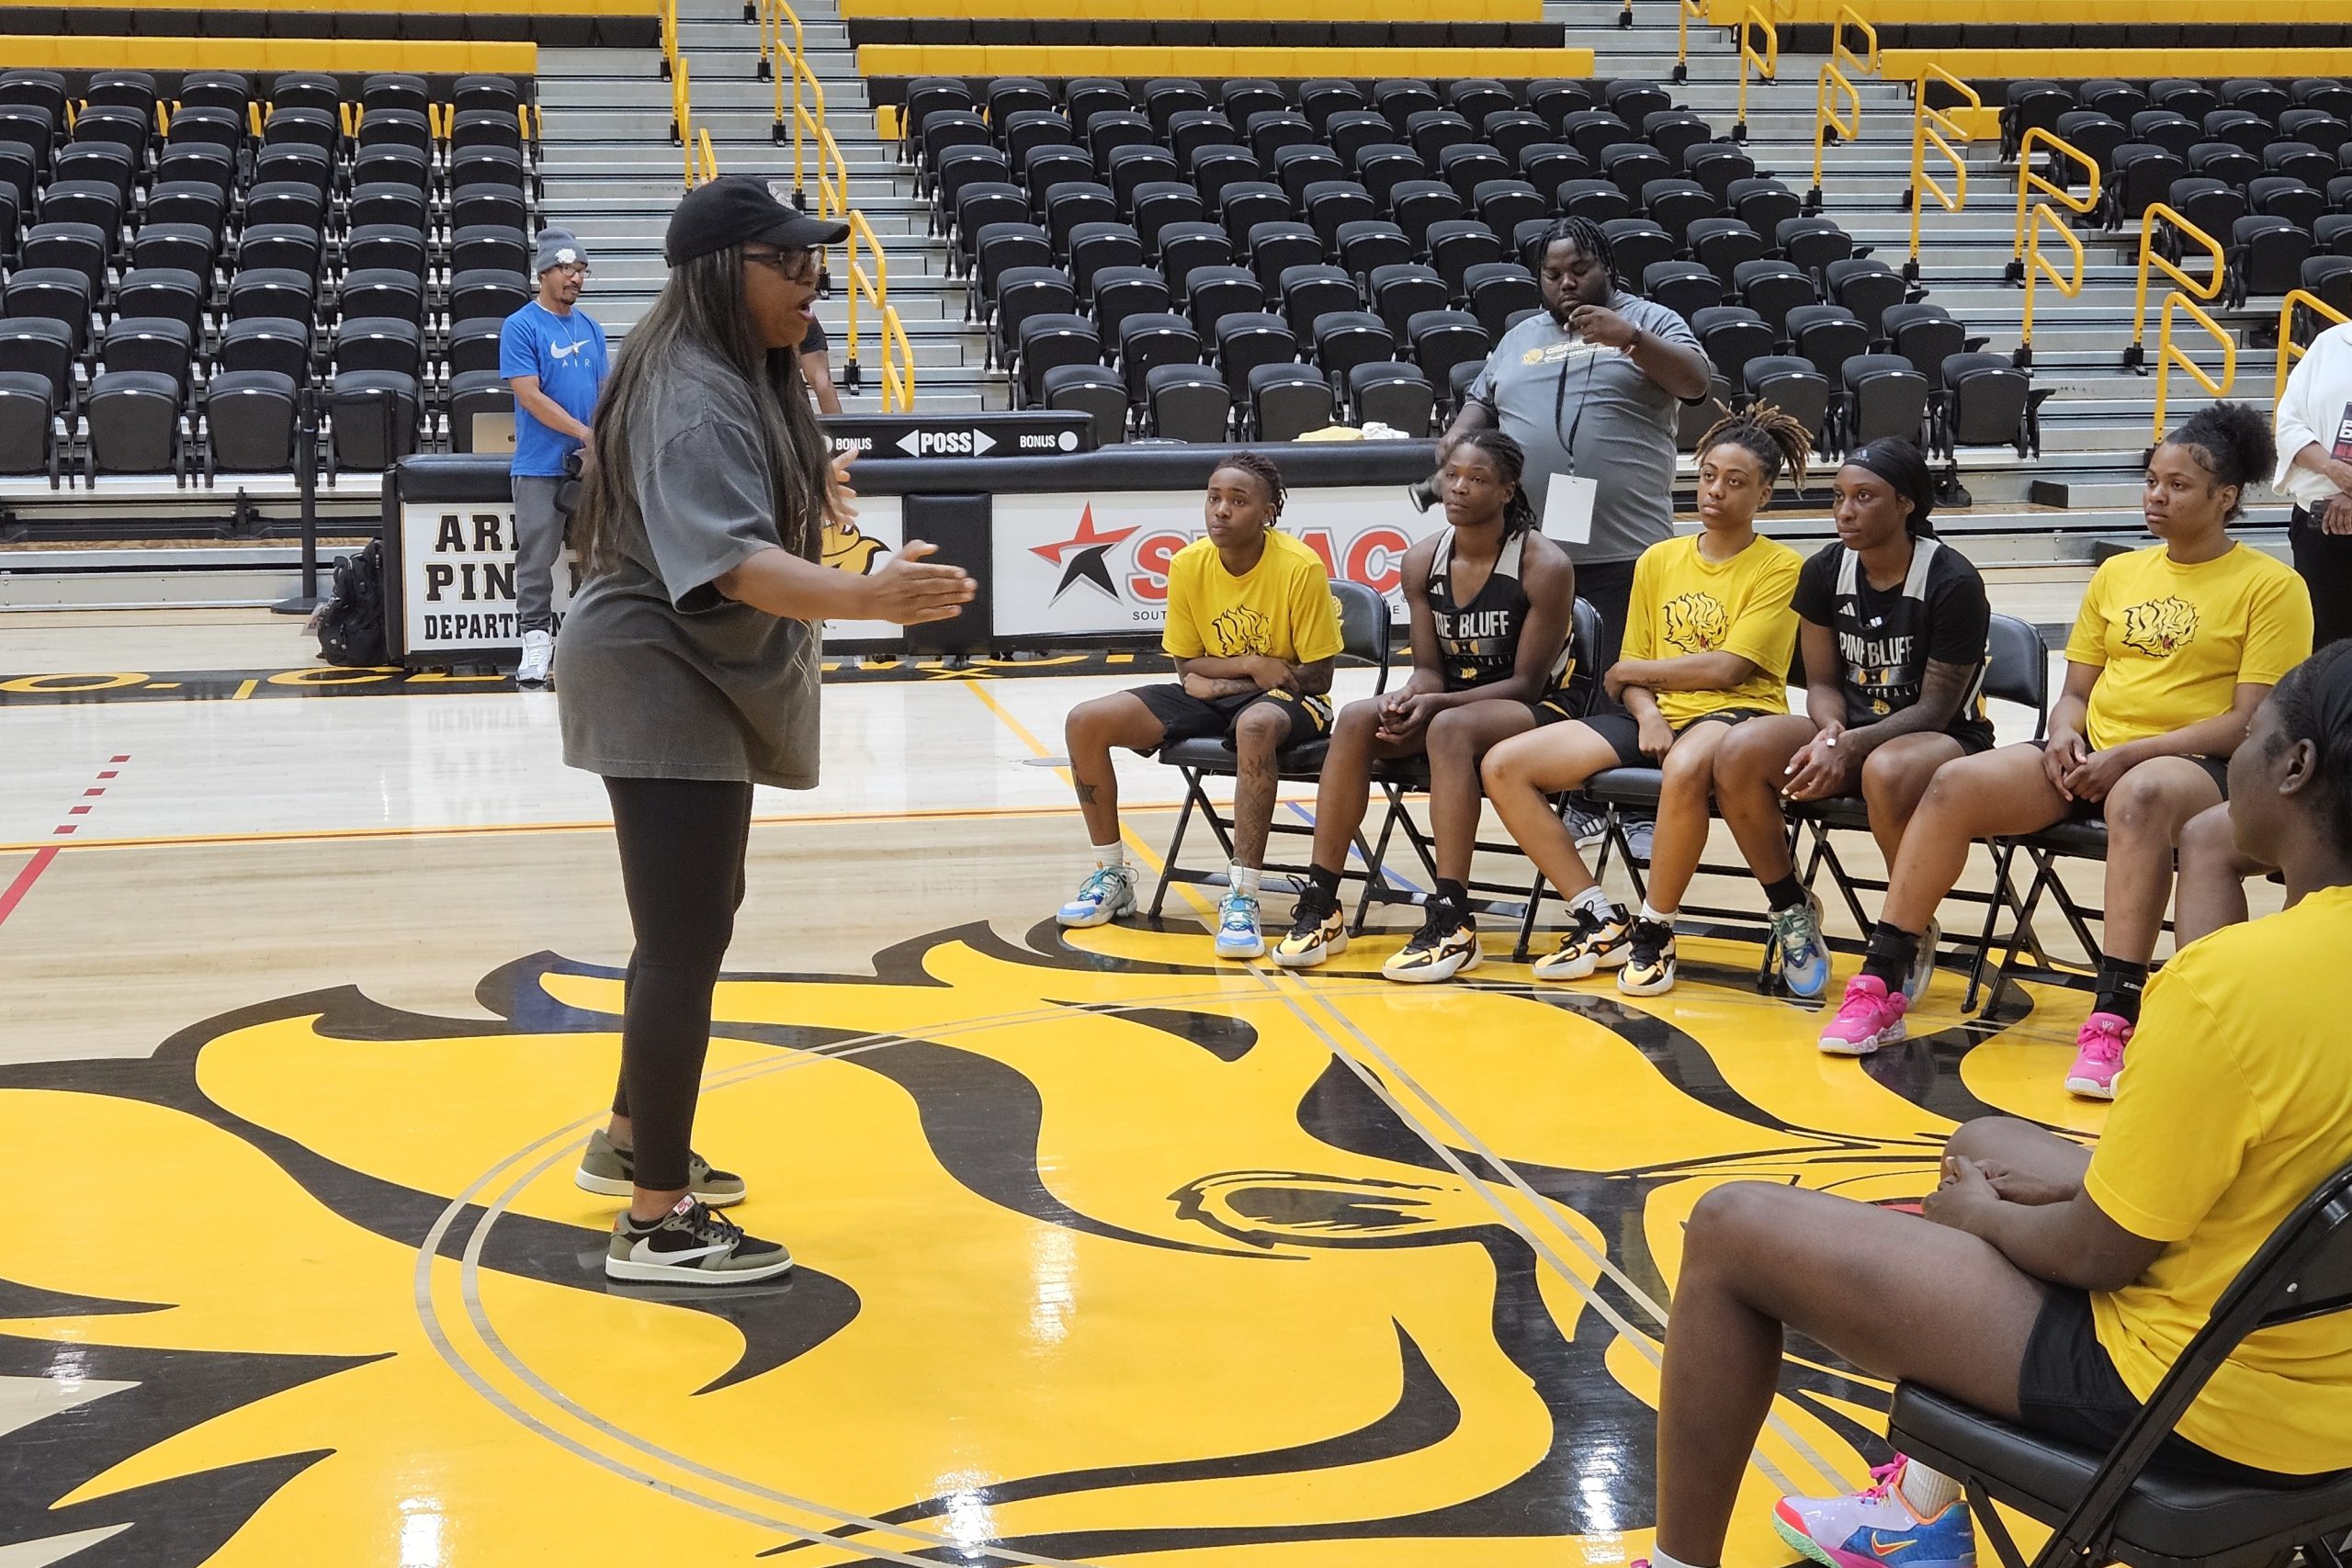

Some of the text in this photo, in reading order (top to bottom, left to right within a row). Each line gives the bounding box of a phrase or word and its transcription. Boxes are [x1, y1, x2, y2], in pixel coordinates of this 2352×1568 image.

[562, 358, 591, 368] AIR
[835, 432, 1056, 454] BONUS POSS BONUS
[425, 563, 515, 602] PIN
[1459, 610, 1509, 638] BLUFF
[1867, 636, 1914, 668] BLUFF
